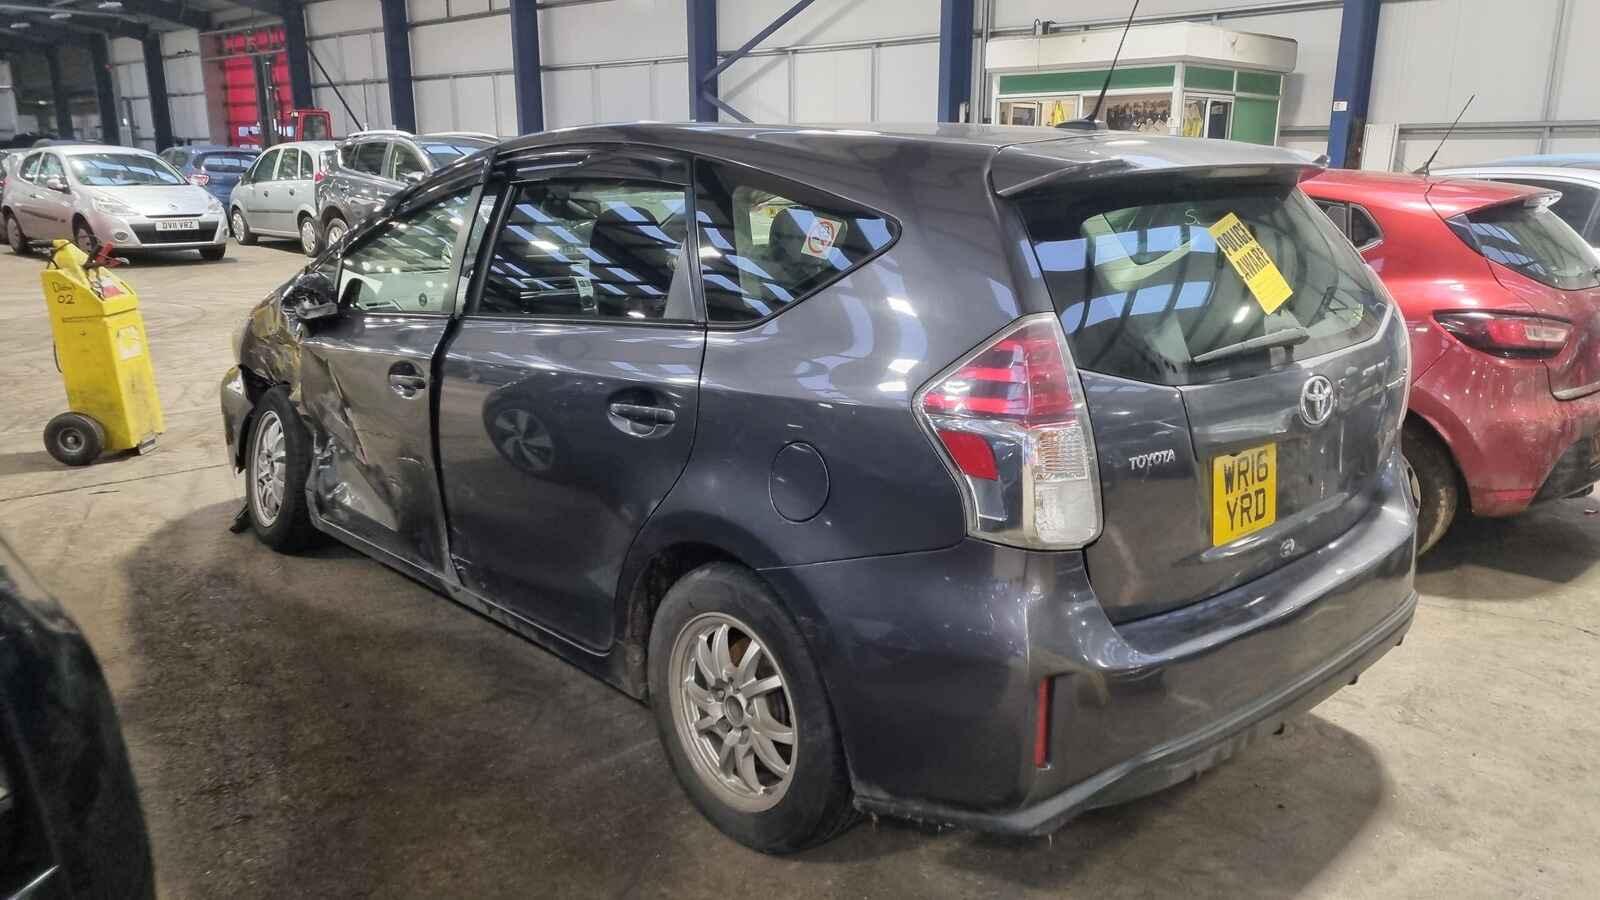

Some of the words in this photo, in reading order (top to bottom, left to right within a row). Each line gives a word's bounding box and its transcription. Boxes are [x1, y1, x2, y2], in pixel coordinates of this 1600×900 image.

[1217, 222, 1253, 256] POLICE
[1236, 247, 1270, 281] AWARE
[1129, 448, 1176, 471] TOYOTA
[1223, 450, 1269, 495] WR16
[1226, 487, 1266, 532] YRD
